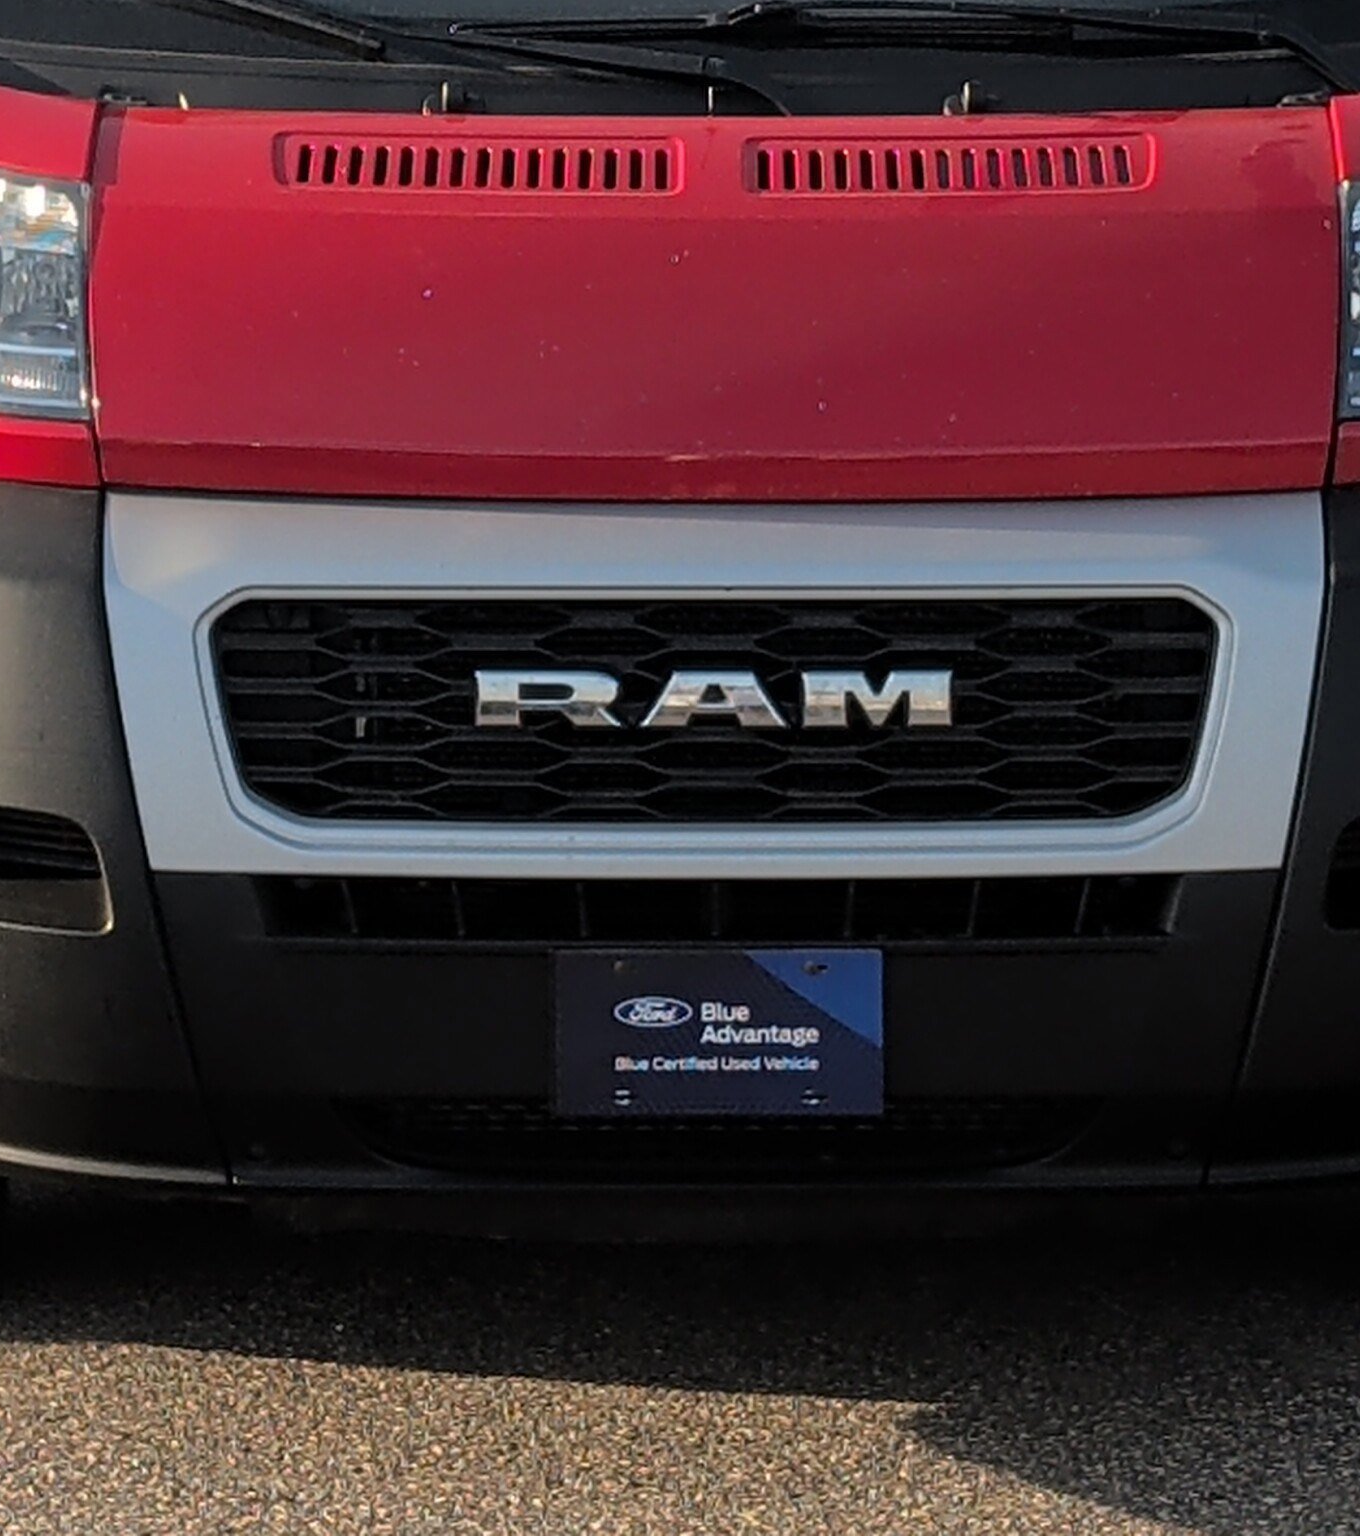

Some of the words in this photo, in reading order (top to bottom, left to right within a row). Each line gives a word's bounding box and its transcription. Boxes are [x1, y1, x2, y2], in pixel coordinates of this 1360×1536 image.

[474, 670, 954, 727] RAM
[700, 1002, 750, 1021] Blue
[700, 1025, 820, 1046] Advantage
[614, 1056, 649, 1071] Blue
[652, 1056, 718, 1071] Certified
[721, 1056, 760, 1071] Used
[764, 1056, 820, 1071] Vehicle
